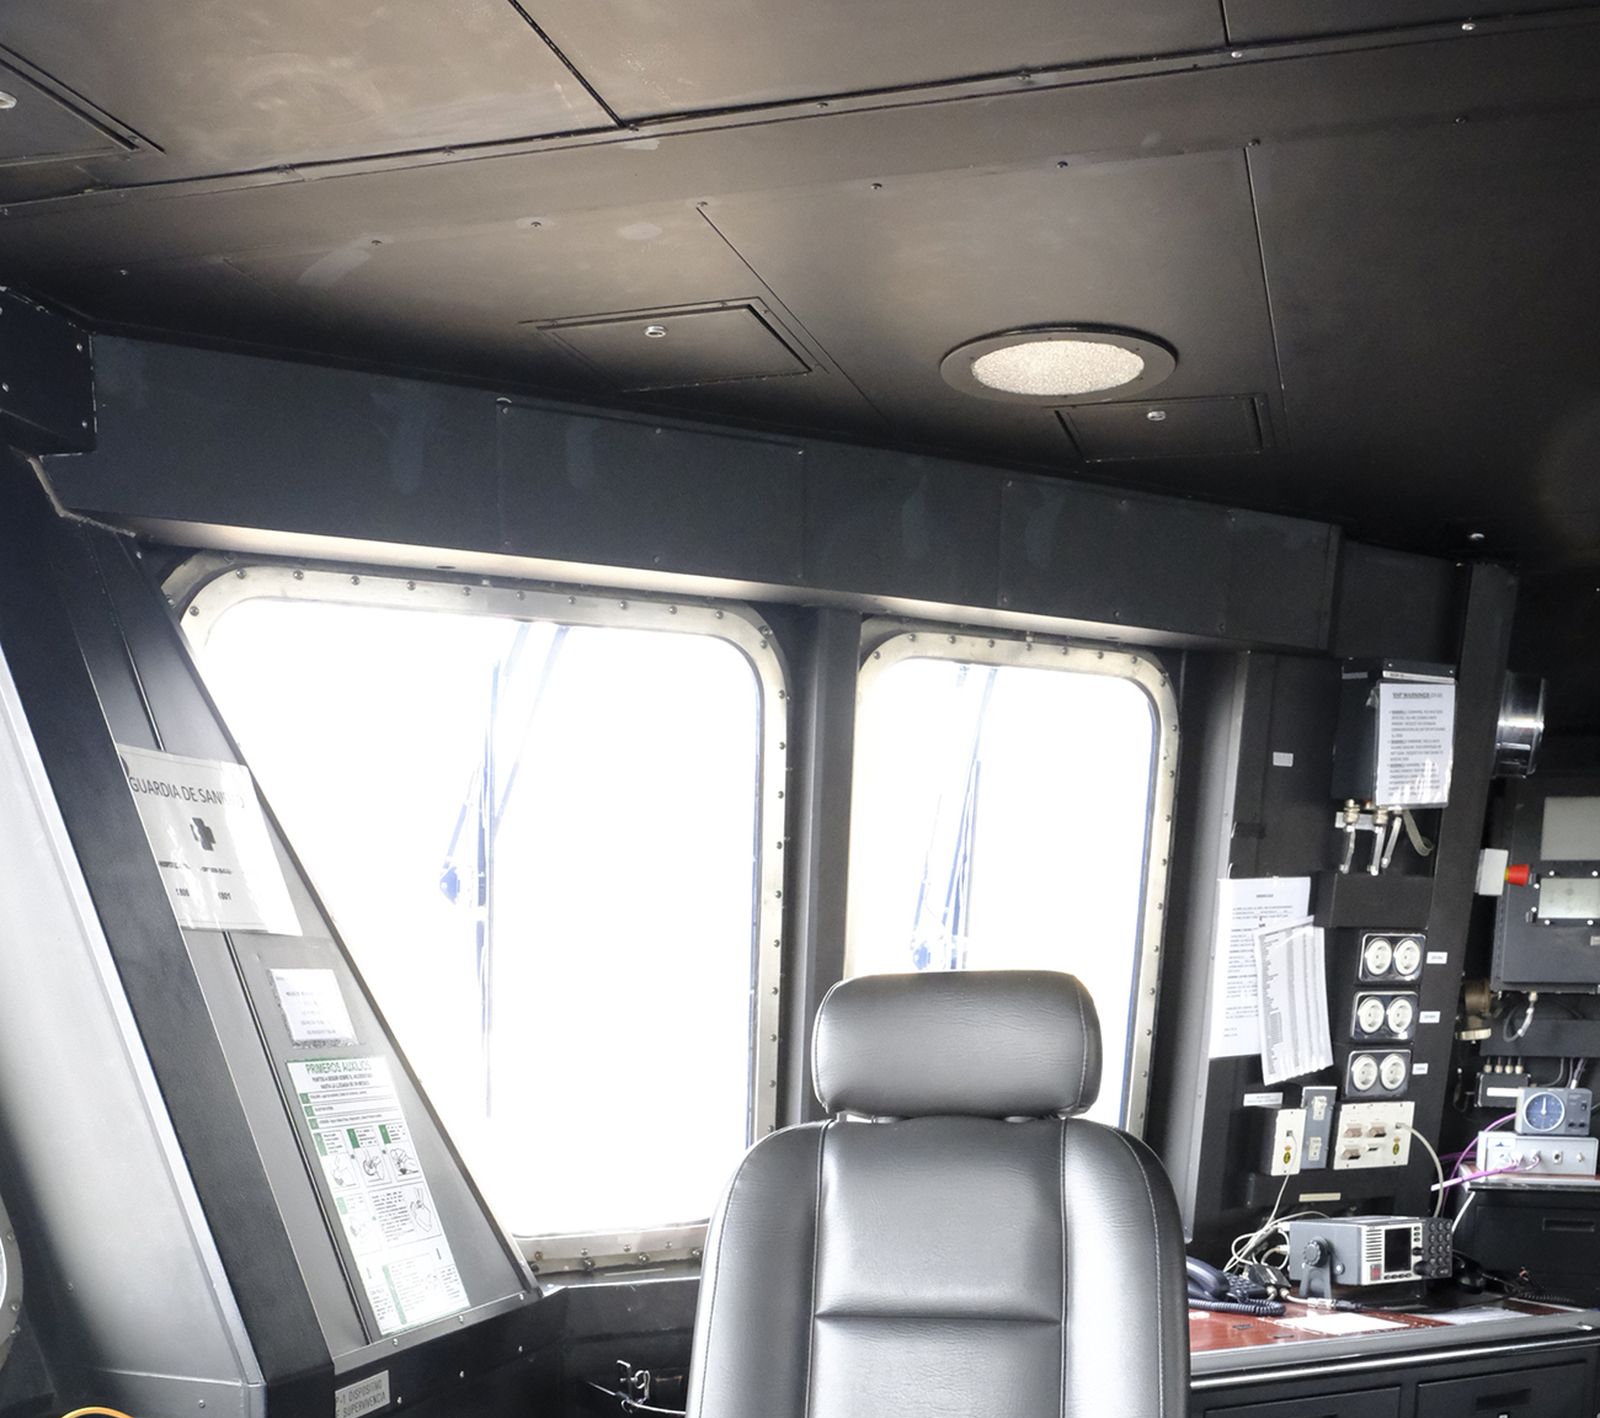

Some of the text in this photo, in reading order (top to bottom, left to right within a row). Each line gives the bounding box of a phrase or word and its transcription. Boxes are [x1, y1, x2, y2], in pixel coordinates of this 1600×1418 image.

[128, 776, 181, 799] GUARDIA
[181, 786, 198, 802] DE
[305, 1062, 341, 1074] PRIMEROS
